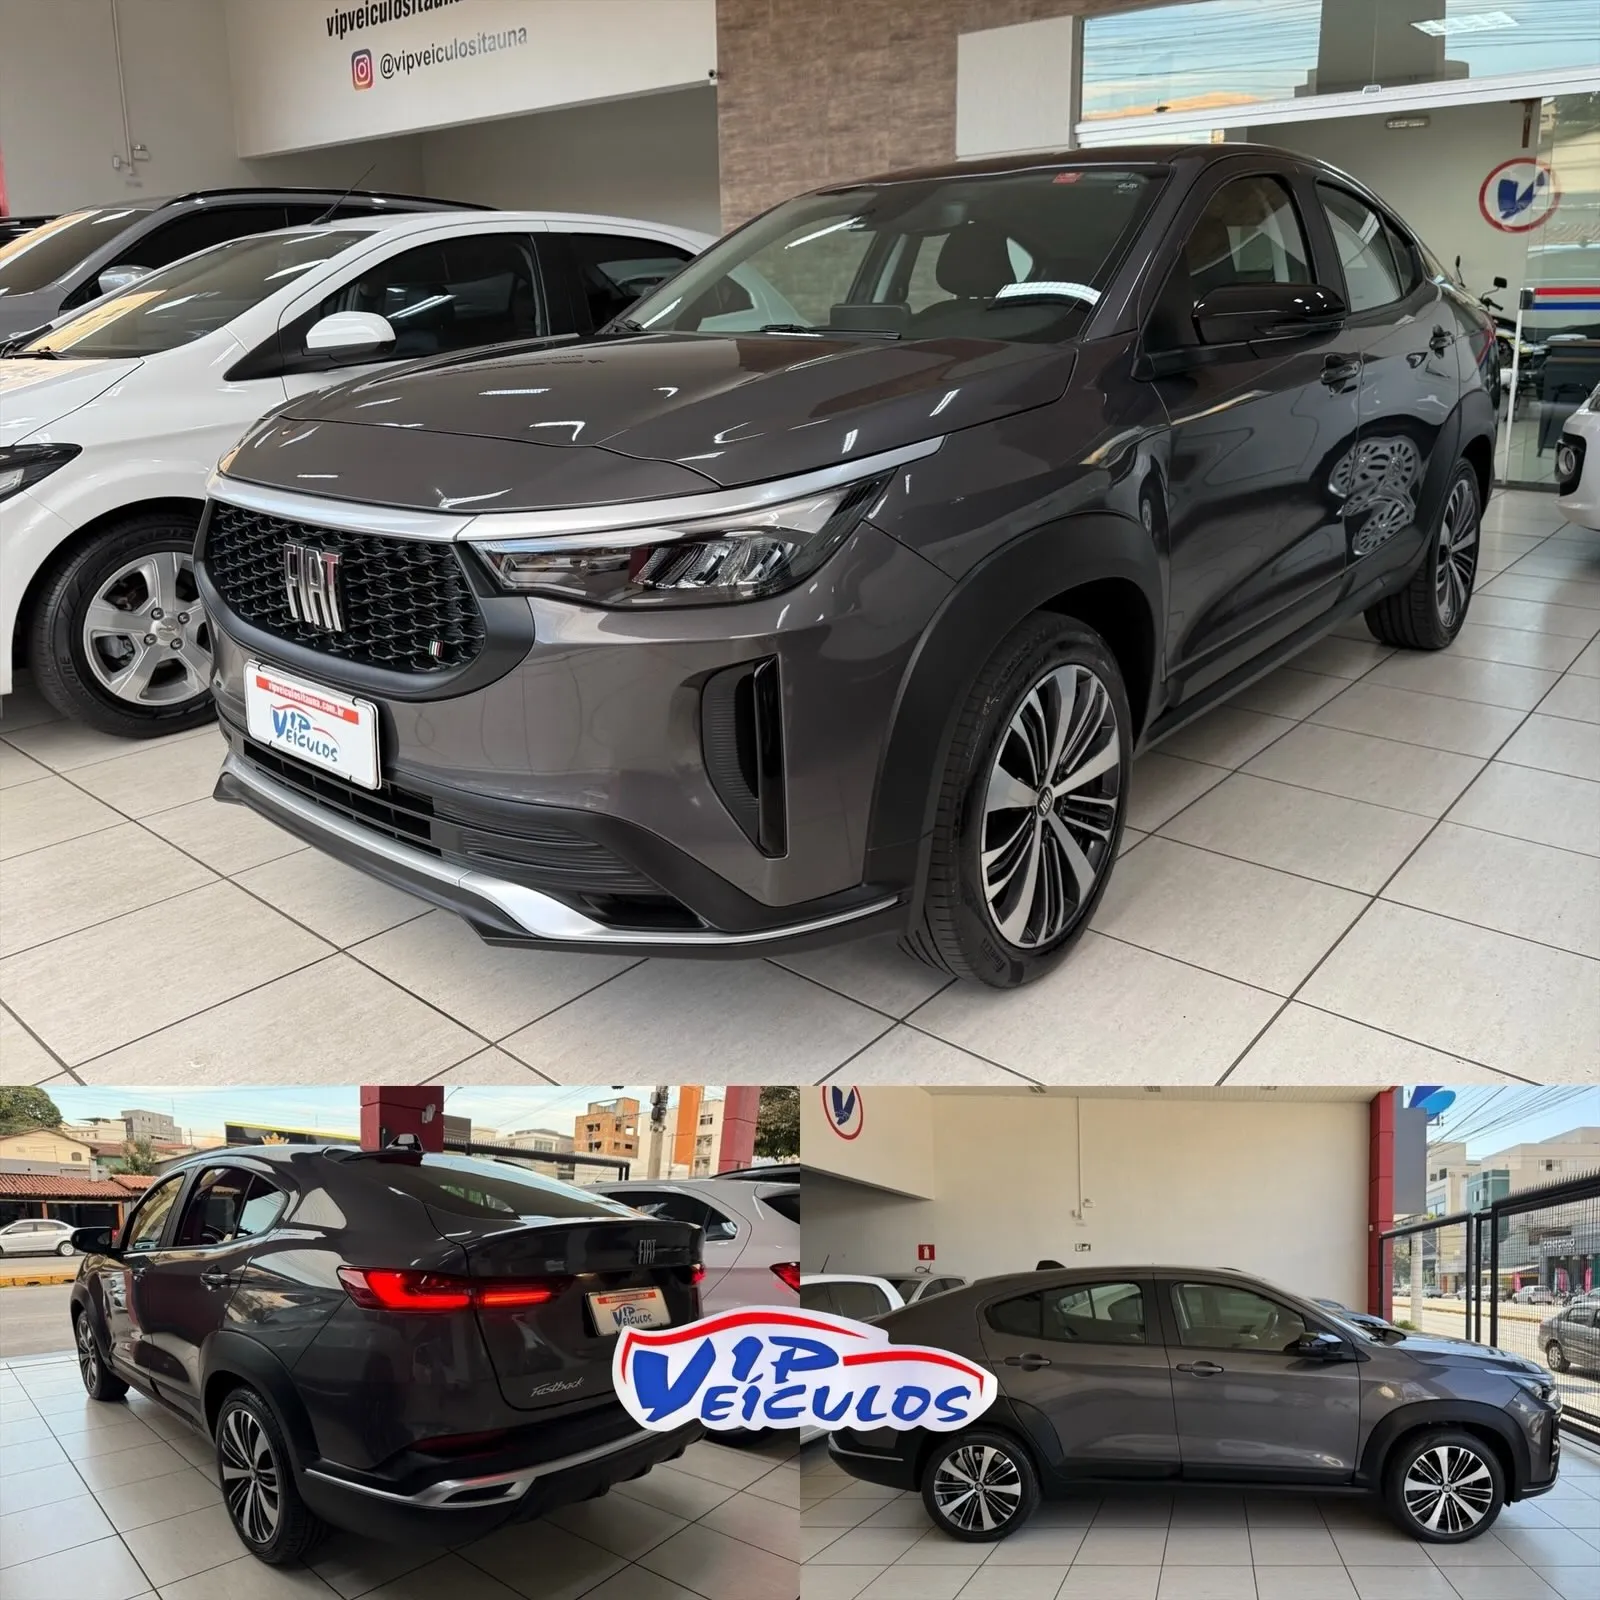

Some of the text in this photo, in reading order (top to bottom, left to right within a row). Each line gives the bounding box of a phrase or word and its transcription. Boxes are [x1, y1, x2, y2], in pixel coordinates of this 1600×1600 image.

[326, 0, 464, 40] vipveiculosita
[380, 26, 528, 79] @vipveiculositauna
[284, 543, 343, 633] FIAT
[273, 709, 311, 739] VIP
[637, 1239, 657, 1265] FIAT
[530, 1376, 585, 1398] Fastback
